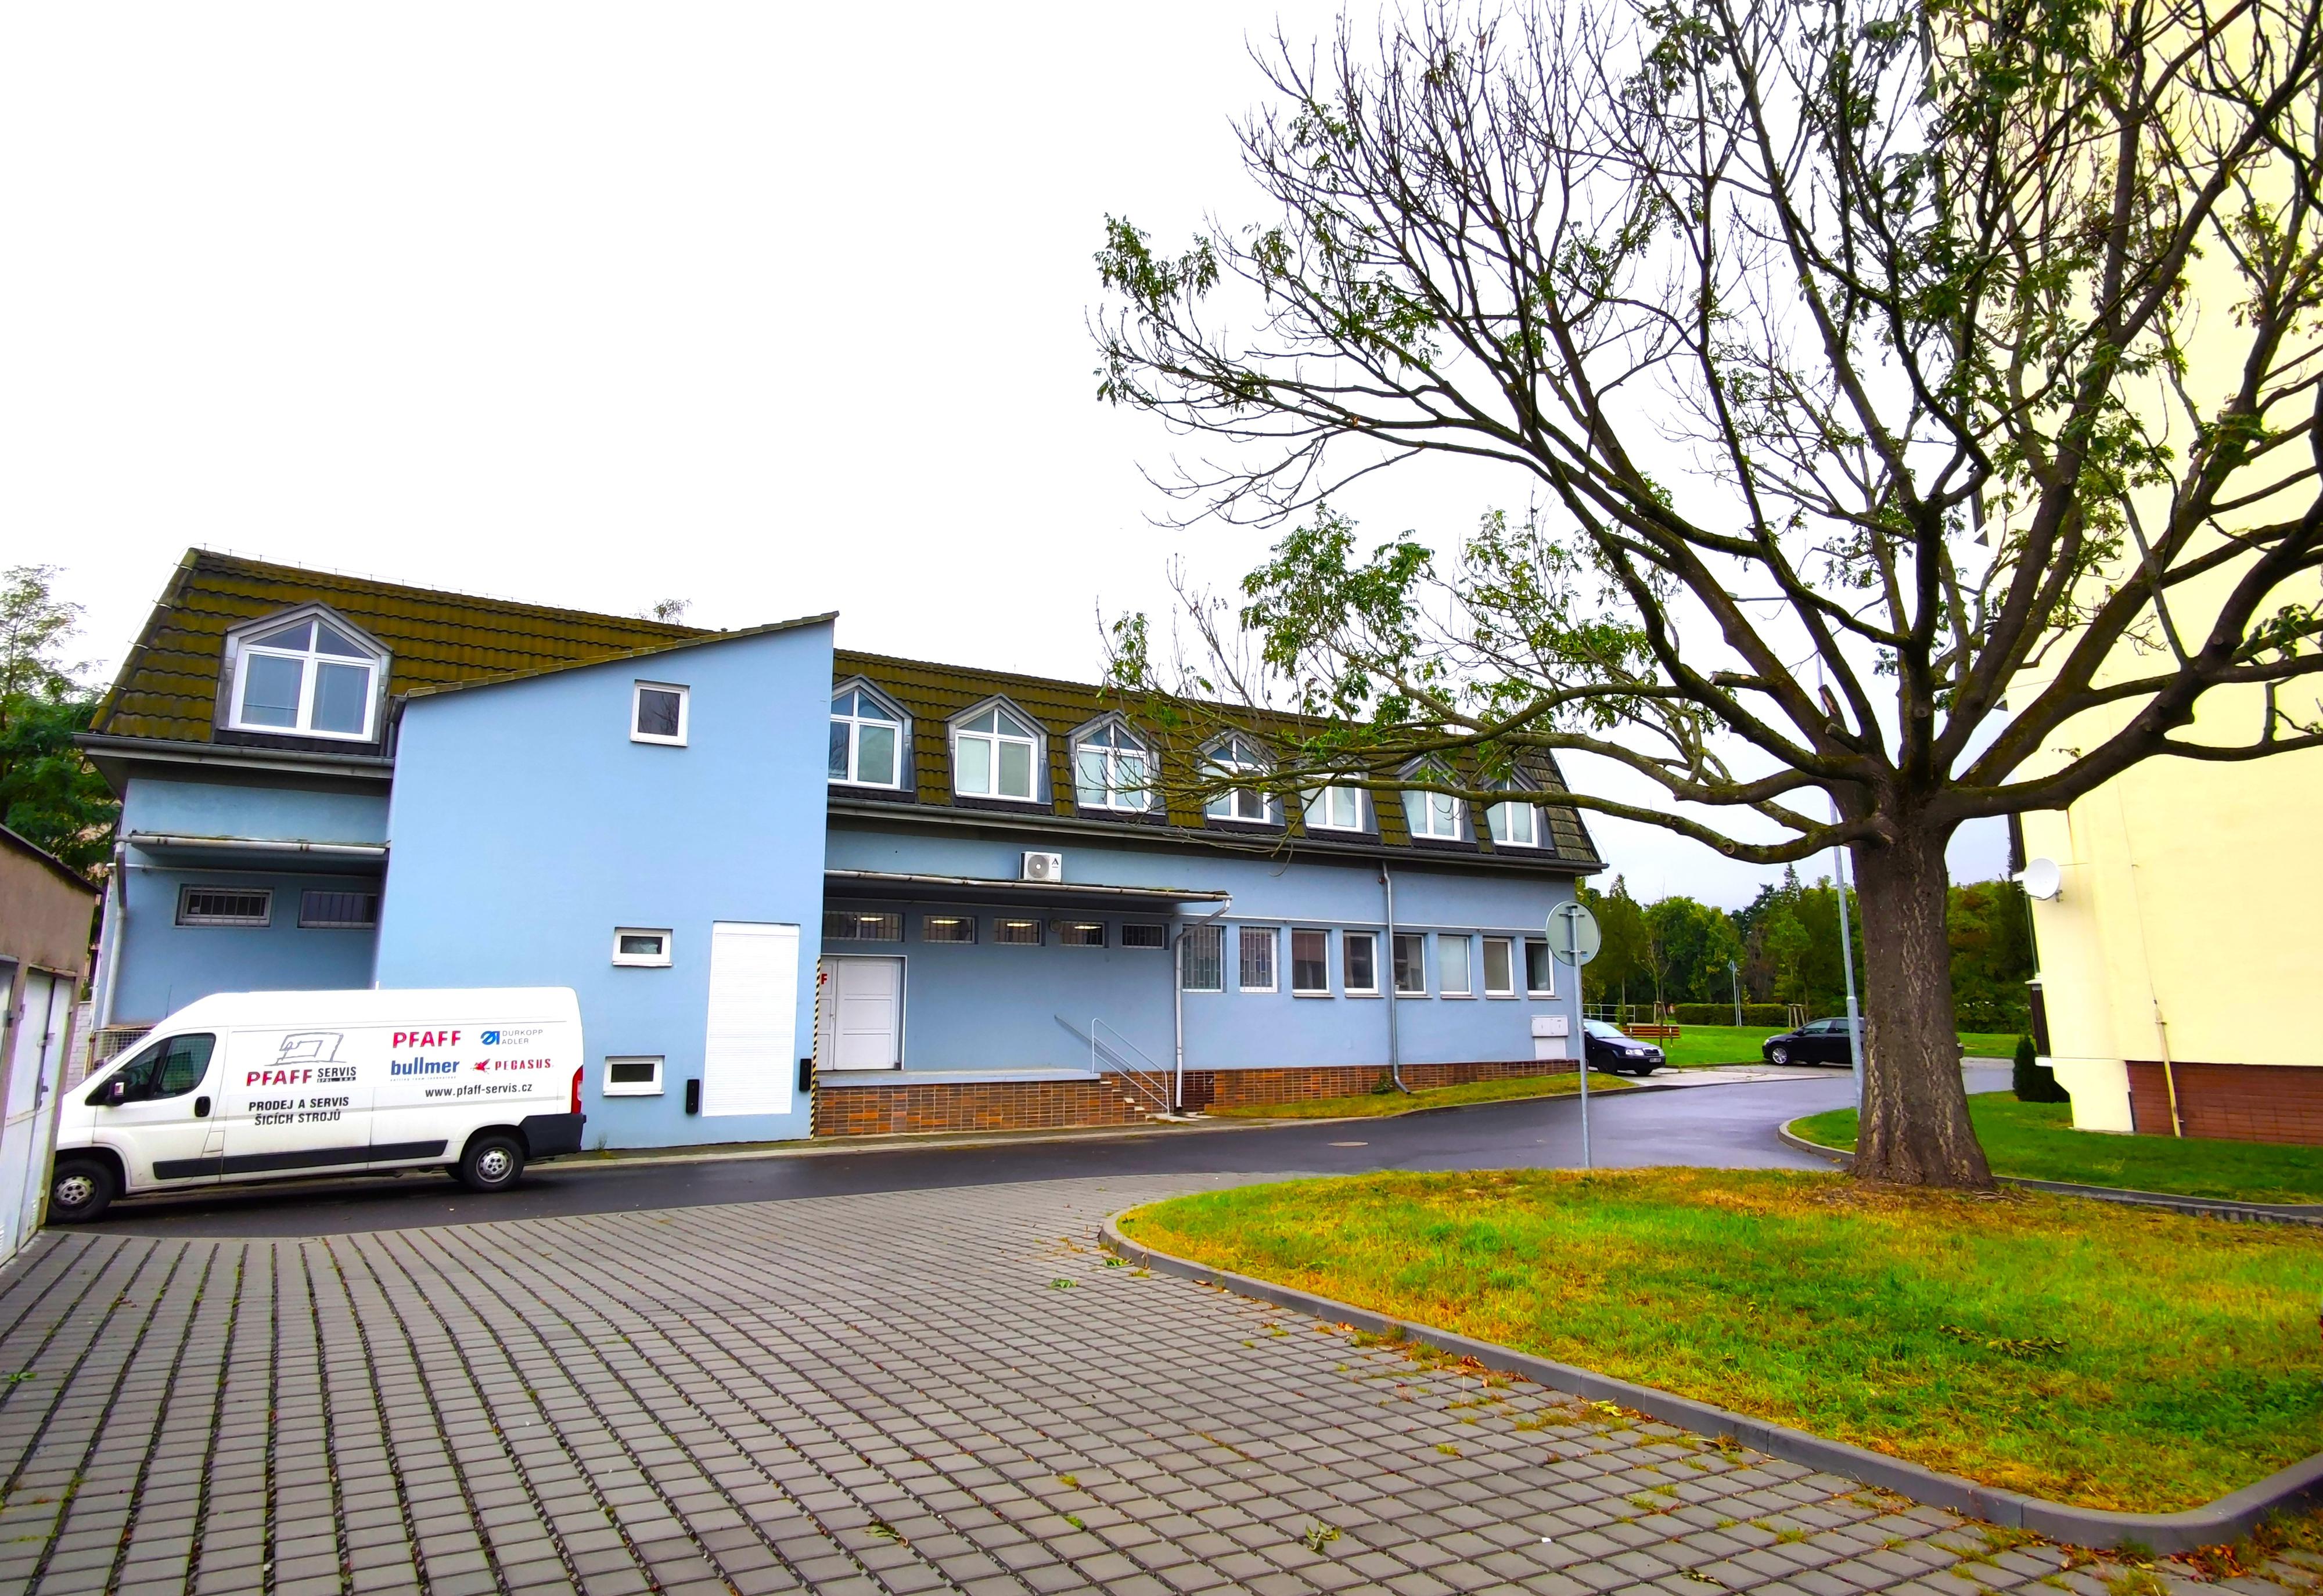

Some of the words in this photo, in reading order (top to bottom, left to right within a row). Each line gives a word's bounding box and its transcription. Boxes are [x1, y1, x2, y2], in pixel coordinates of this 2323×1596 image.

[393, 1031, 461, 1049] PFAFF
[390, 1057, 460, 1075] bullmer
[495, 1058, 551, 1071] PEGASUS
[246, 1069, 312, 1086] PFAFF
[318, 1067, 357, 1078] SERVIS
[425, 1083, 533, 1098] www.pfaff-servis.cz
[249, 1100, 293, 1111] PRODEJ
[298, 1099, 305, 1109] A
[310, 1097, 349, 1108] SERVIS
[254, 1112, 293, 1126] ŠICÍCH
[298, 1109, 341, 1123] STROJŮ
